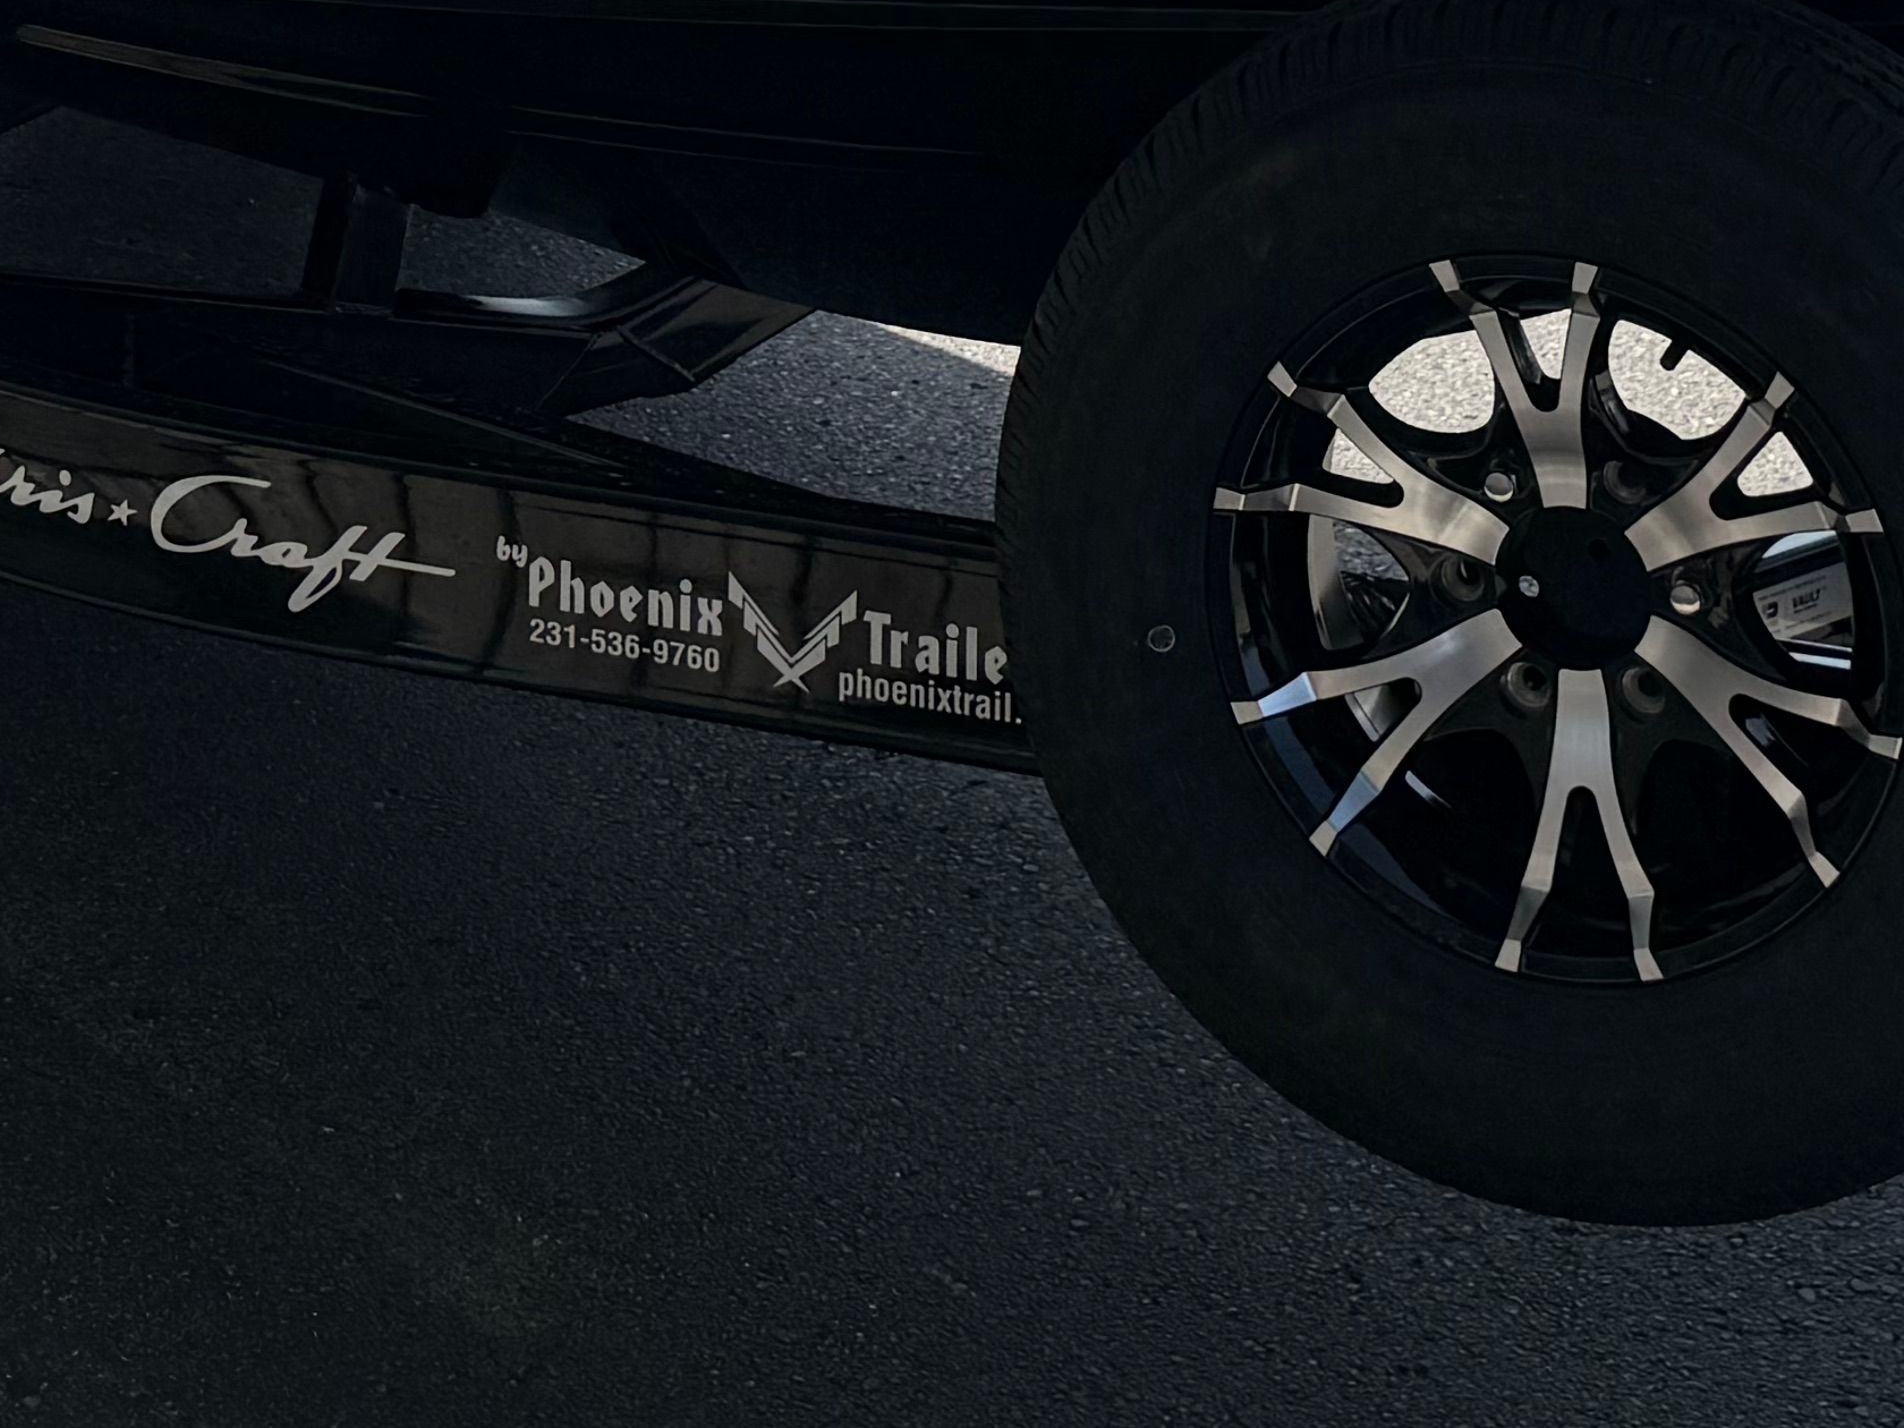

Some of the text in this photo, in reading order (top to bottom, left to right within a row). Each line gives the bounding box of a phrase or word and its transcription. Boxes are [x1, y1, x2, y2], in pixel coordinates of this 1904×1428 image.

[151, 474, 456, 613] Craft
[497, 536, 527, 567] by
[528, 556, 723, 637] Phoenix
[529, 618, 721, 673] 231-536-9760
